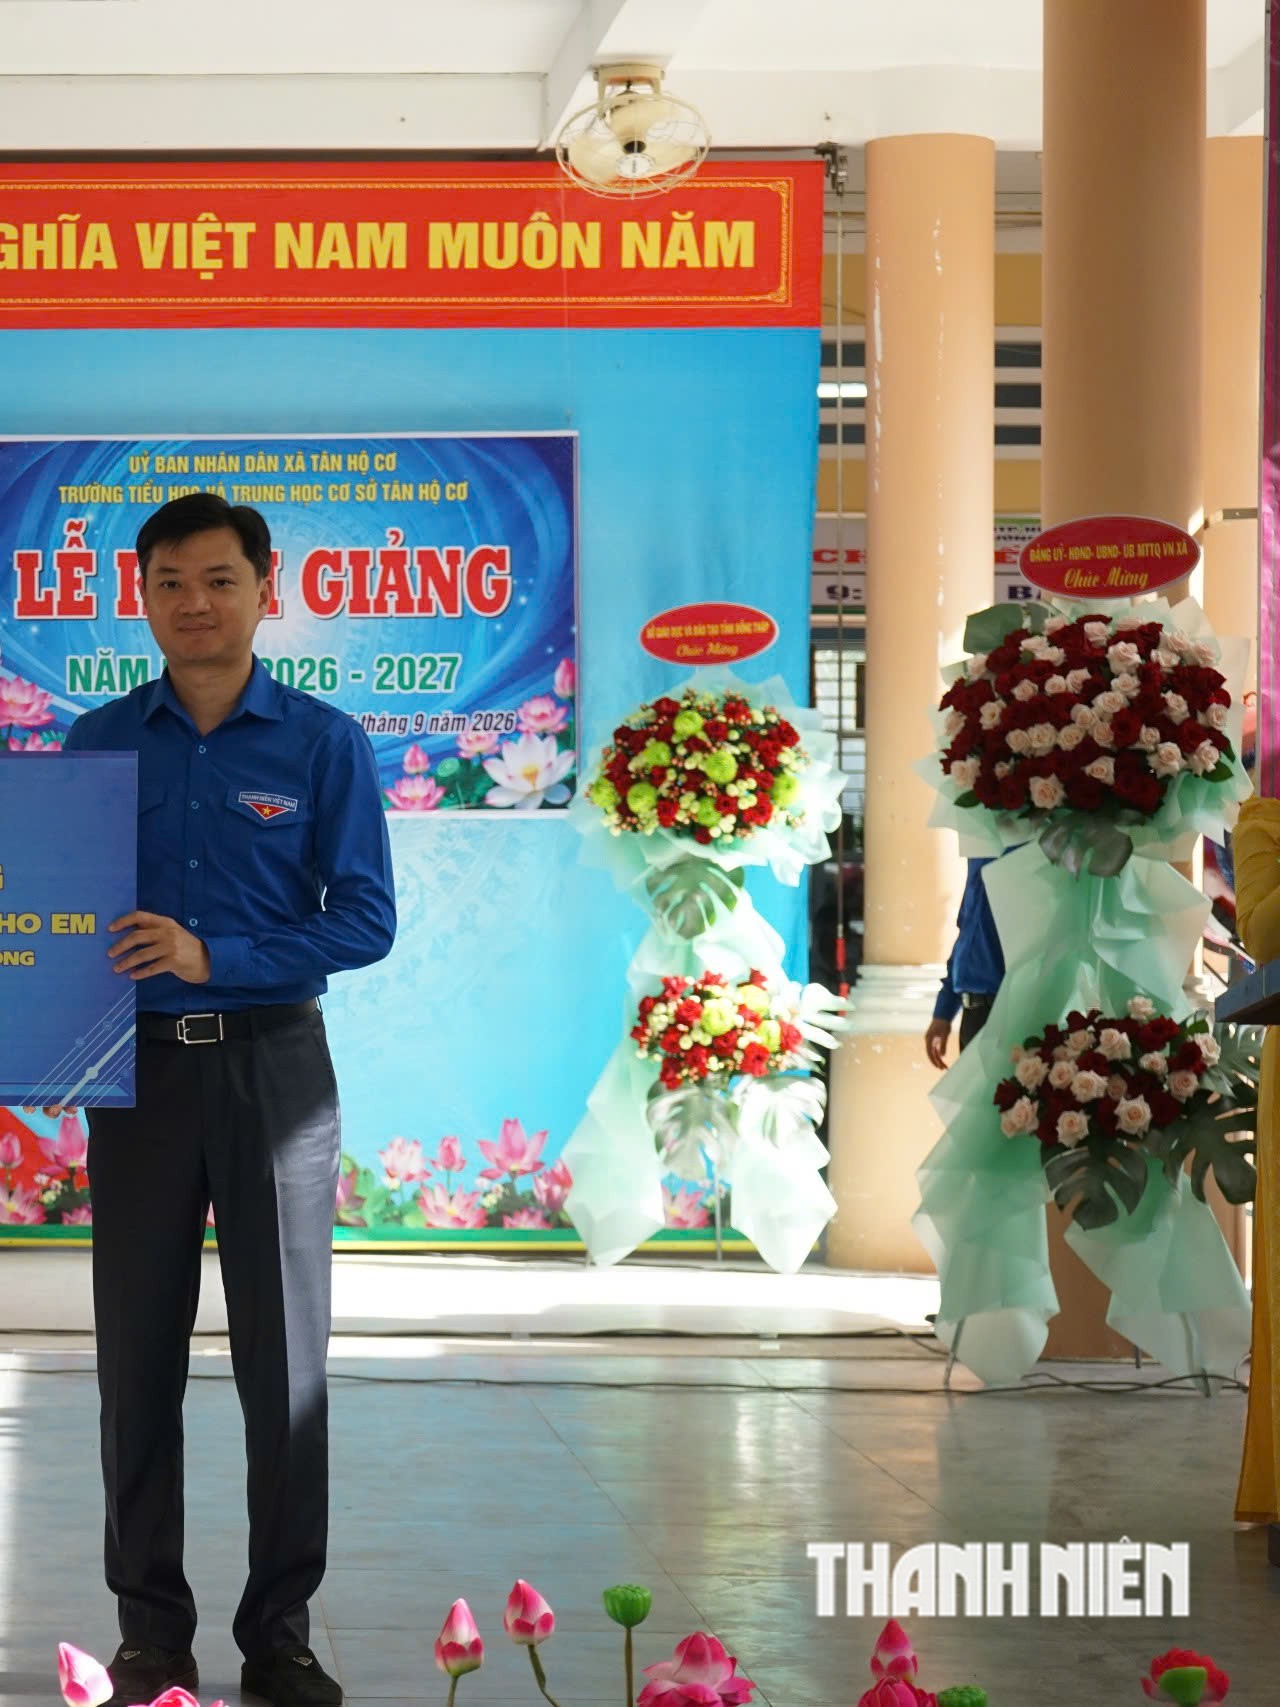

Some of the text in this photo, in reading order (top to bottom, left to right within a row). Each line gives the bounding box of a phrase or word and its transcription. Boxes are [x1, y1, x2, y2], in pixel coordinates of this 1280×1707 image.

[135, 212, 256, 280] VIỆT
[274, 222, 407, 269] NAM
[428, 212, 600, 269] MUÔN
[622, 211, 754, 268] NĂM
[154, 455, 189, 473] BAN
[193, 452, 240, 473] NHÂN
[245, 451, 279, 472] DÂN
[284, 451, 306, 472] XÃ
[310, 450, 343, 472] TÂN
[347, 450, 370, 475] HỘ
[373, 452, 397, 472] CƠ
[58, 481, 123, 503] TRƯỜNG
[127, 479, 163, 503] TIỂU
[231, 485, 285, 502] TRUNG
[289, 484, 323, 506] HỌC
[328, 482, 351, 502] CƠ
[355, 478, 378, 502] SỞ
[382, 480, 413, 502] TÂN
[418, 479, 440, 504] HỘ
[445, 481, 469, 501] CƠ
[14, 518, 96, 619] LỄ
[301, 528, 513, 619] GIẢNG
[66, 647, 152, 694] NĂM
[374, 654, 461, 694] 2027
[361, 712, 516, 735] tháng 9 năm 2026
[51, 913, 97, 935] EM
